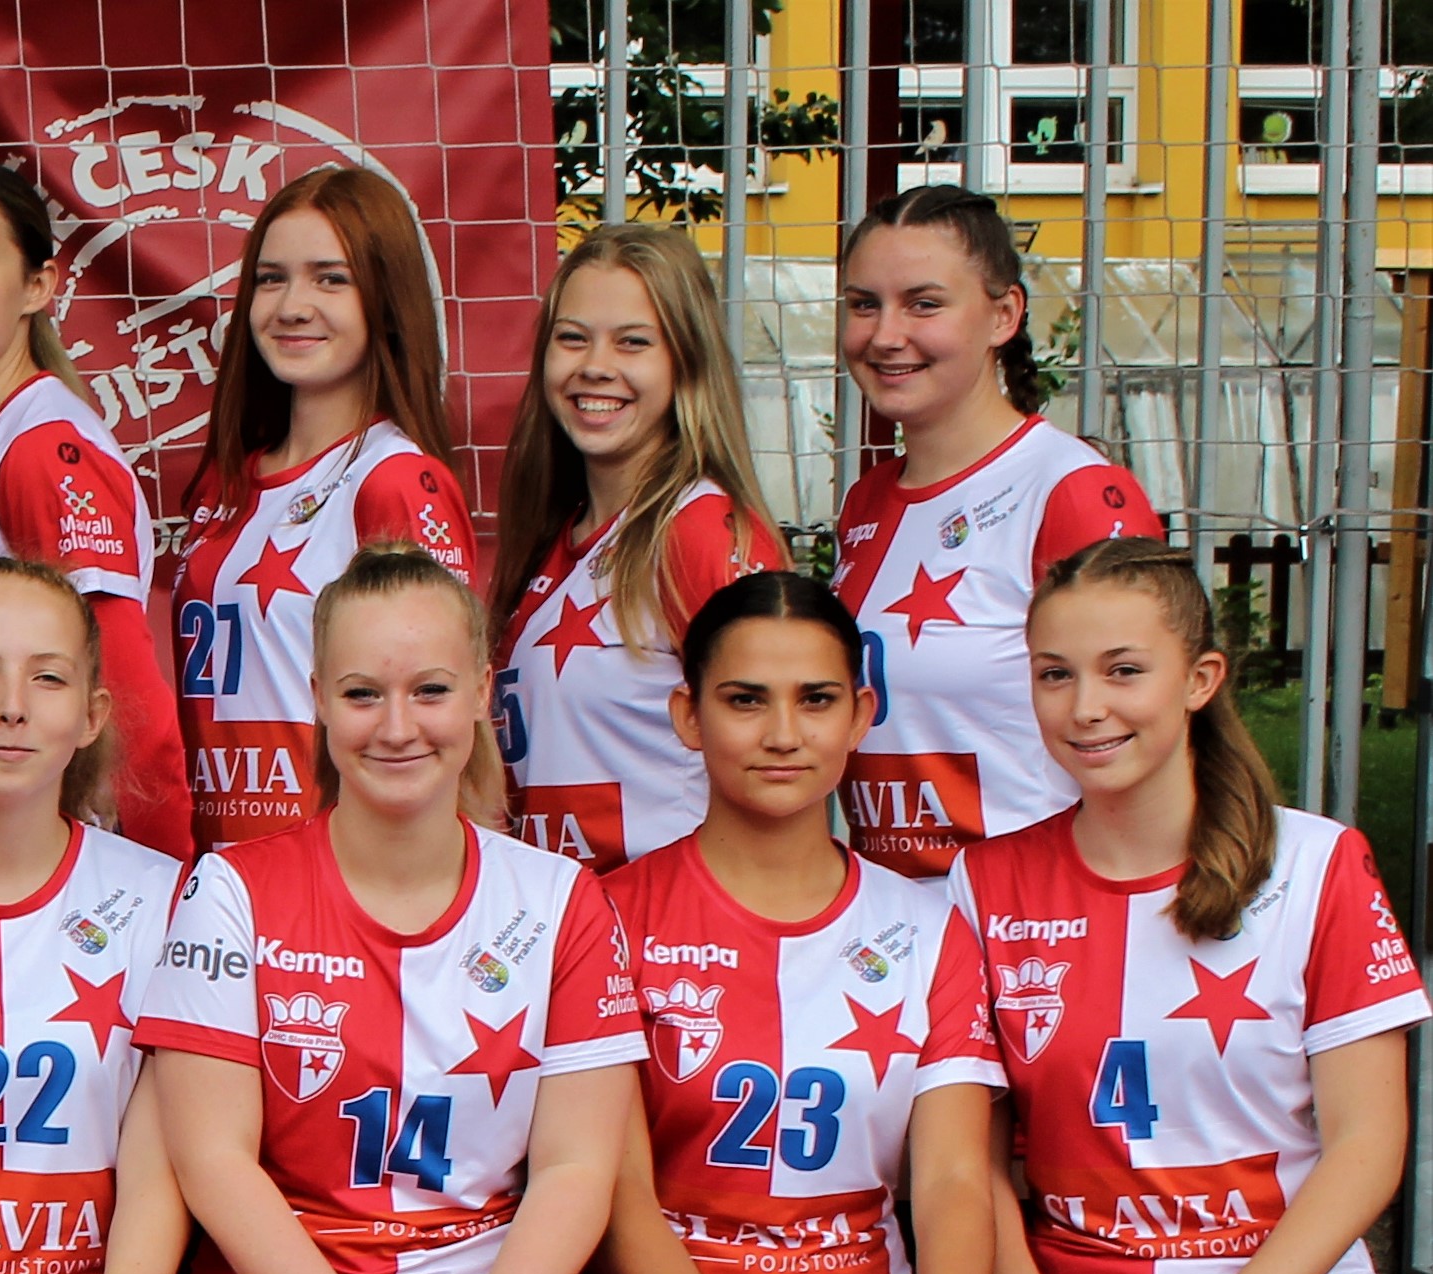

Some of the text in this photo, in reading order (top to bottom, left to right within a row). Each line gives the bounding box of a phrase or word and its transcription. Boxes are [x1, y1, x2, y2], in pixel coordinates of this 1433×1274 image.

[179, 599, 243, 699] 27
[193, 747, 302, 794] AVIA
[1249, 892, 1280, 918] Praha
[512, 921, 547, 965] Praha 10
[644, 936, 739, 972] Kempa
[987, 914, 1088, 947] Kempa
[256, 936, 365, 984] Kempa
[267, 1031, 340, 1049] DHC Slavia Praha
[1089, 1037, 1159, 1144] 4
[706, 1060, 846, 1172] 23
[339, 1087, 453, 1193] 14
